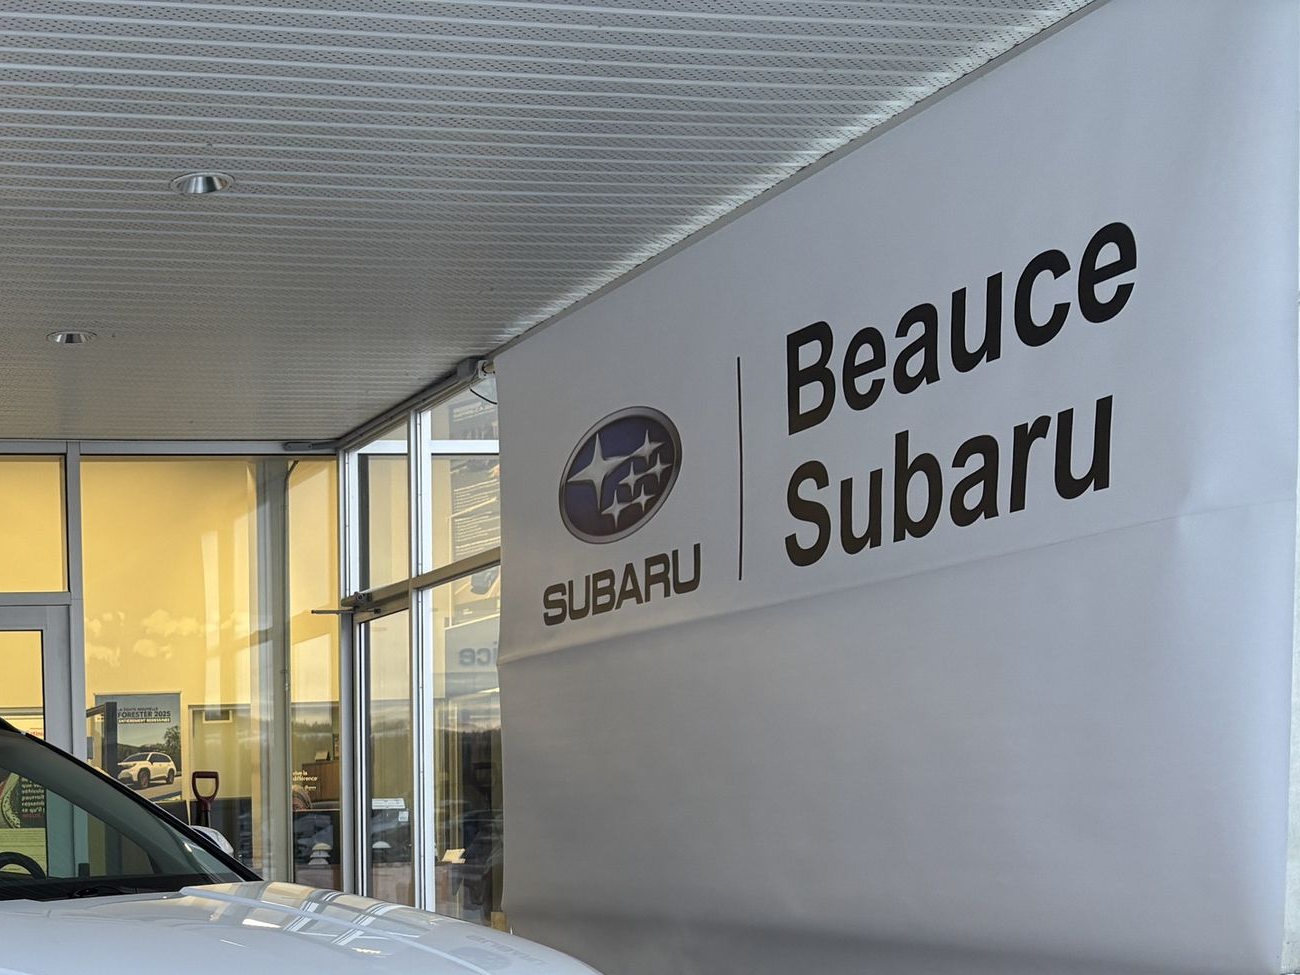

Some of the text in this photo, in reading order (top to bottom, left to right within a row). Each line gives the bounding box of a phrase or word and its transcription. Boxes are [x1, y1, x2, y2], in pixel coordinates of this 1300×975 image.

[785, 221, 1137, 435] Beauce
[784, 394, 1114, 567] Subaru
[543, 542, 702, 626] SUBARU
